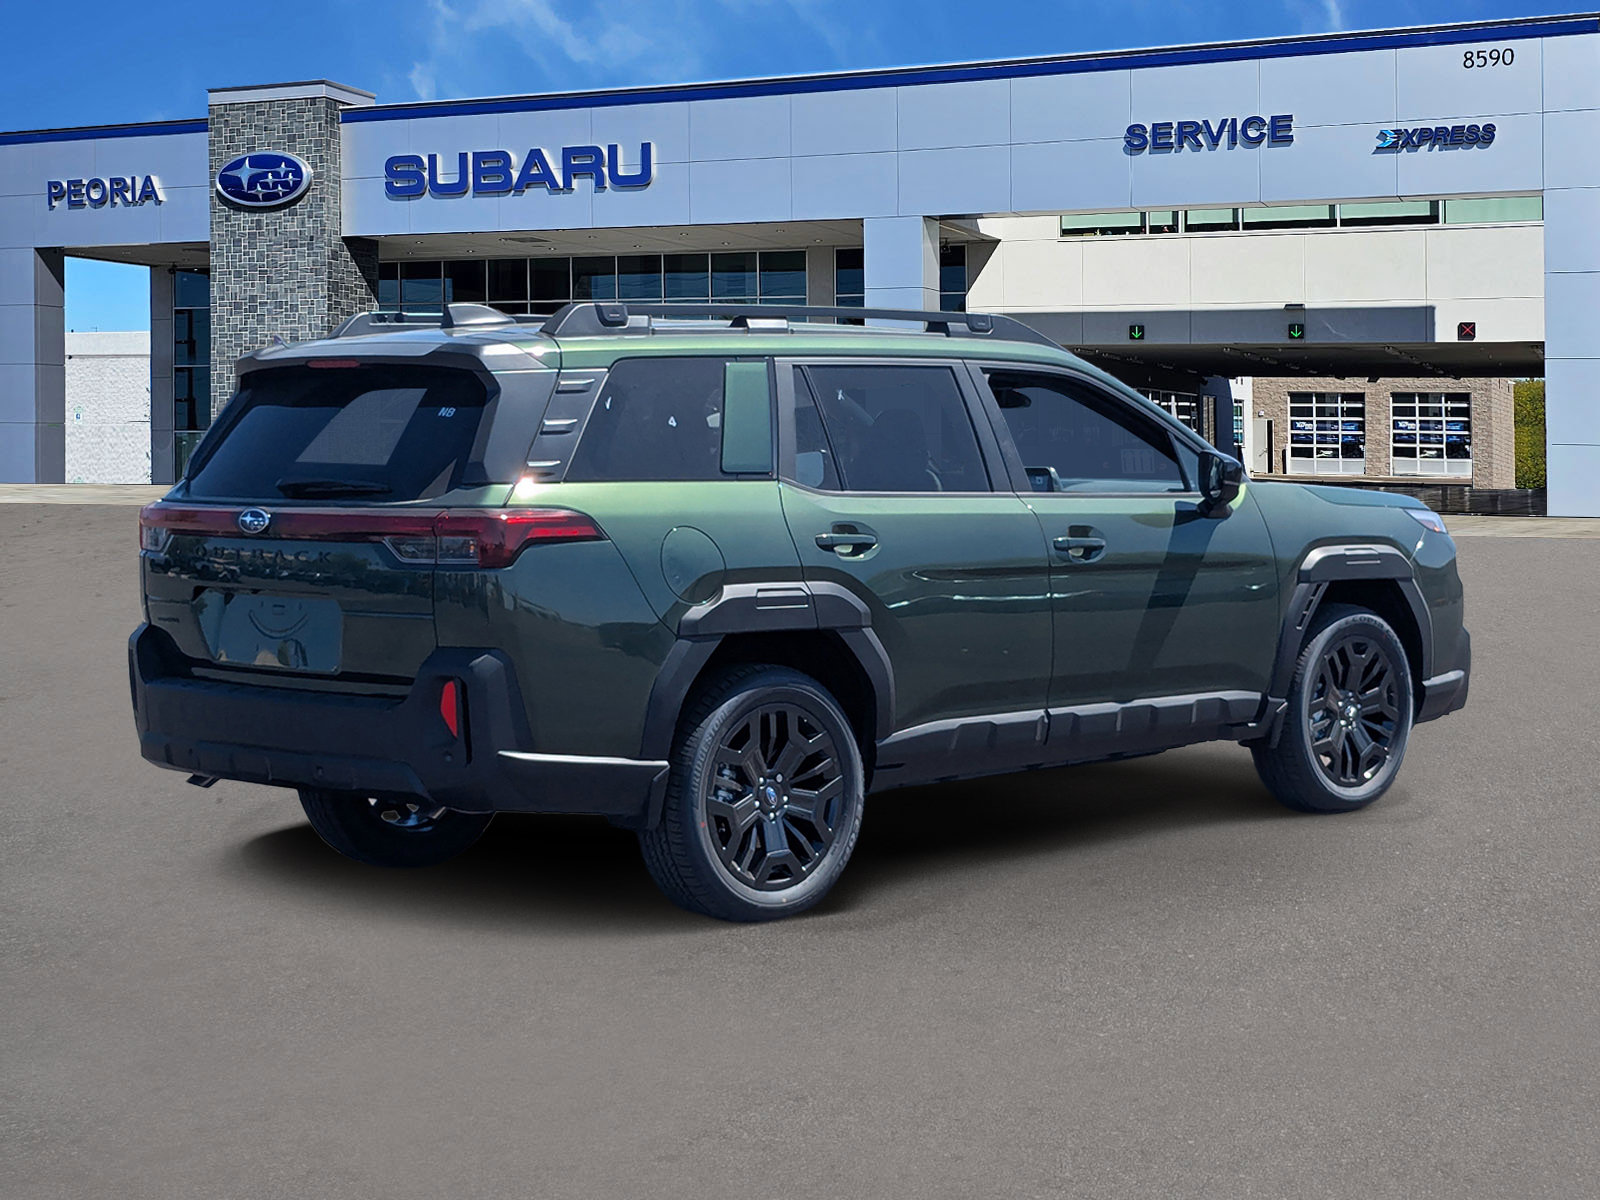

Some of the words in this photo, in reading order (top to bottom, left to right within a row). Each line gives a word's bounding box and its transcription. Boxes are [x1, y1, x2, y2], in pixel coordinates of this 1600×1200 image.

[1463, 48, 1515, 69] 8590
[1124, 114, 1294, 152] SERVICE
[1375, 123, 1497, 150] EXPRESS
[384, 142, 654, 198] SUBARU
[47, 175, 163, 209] PEORIA
